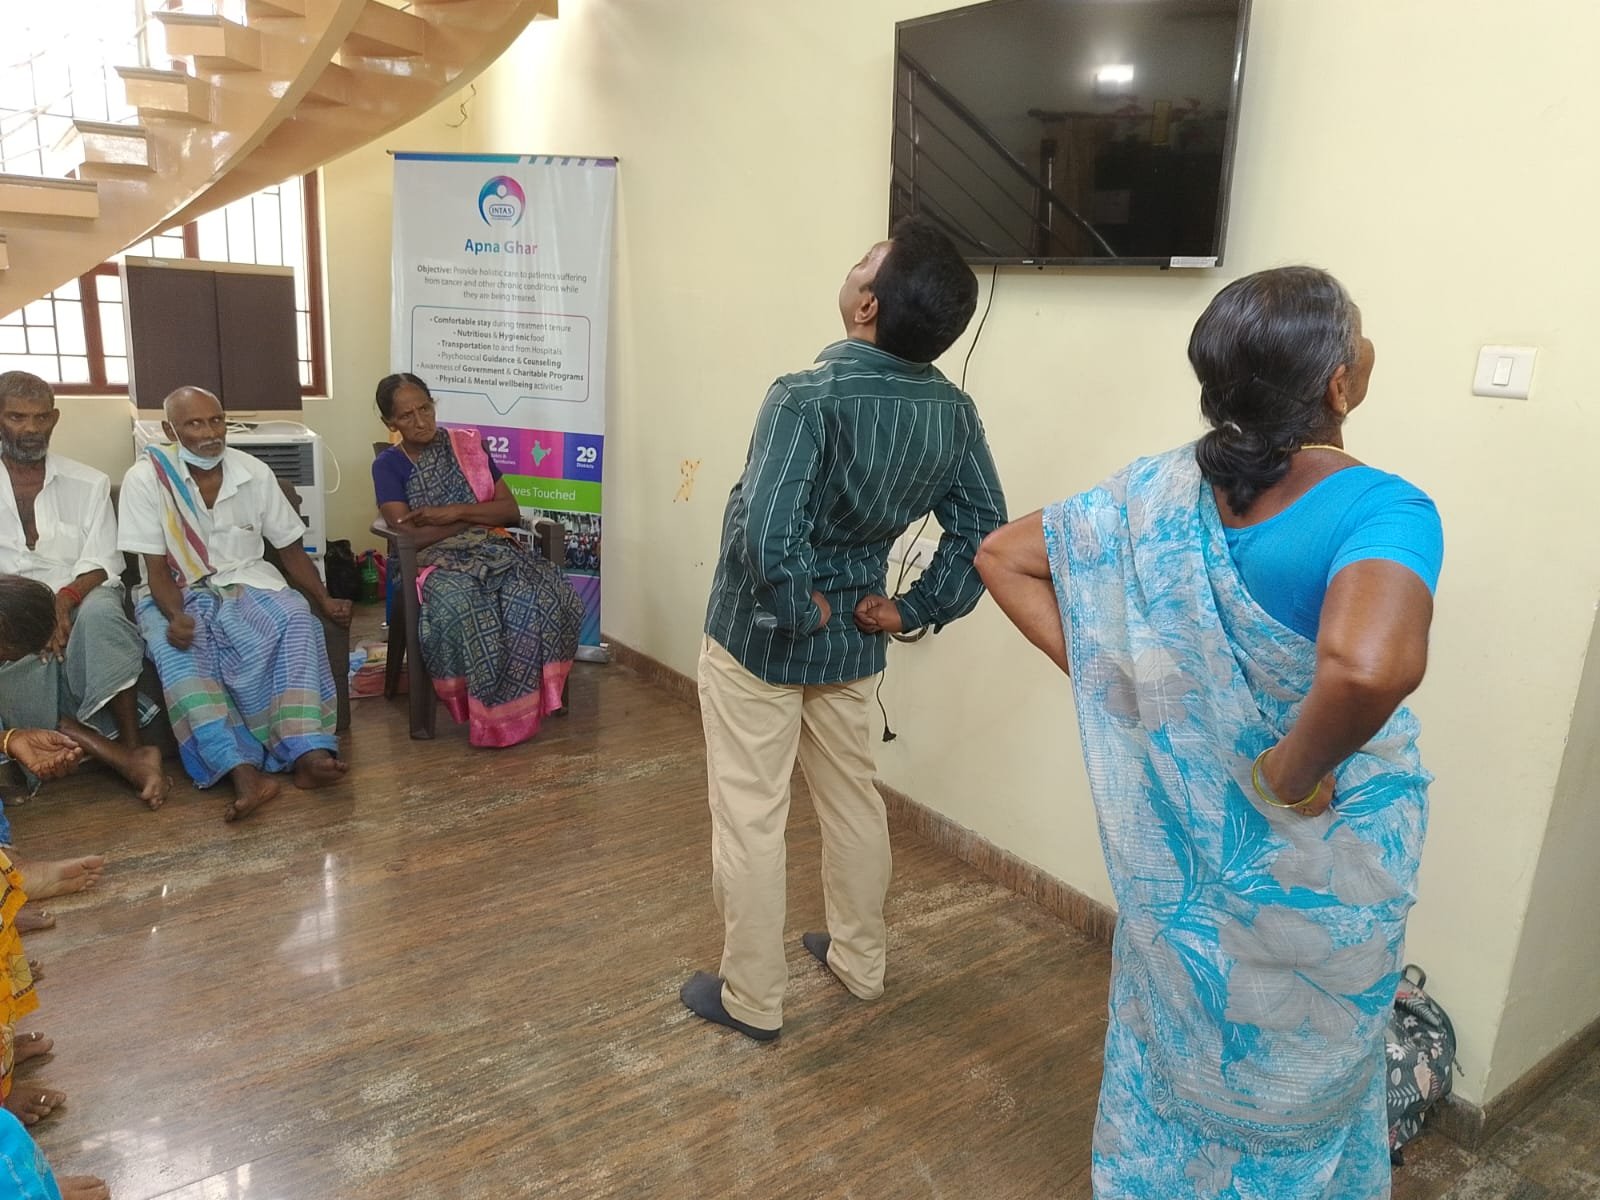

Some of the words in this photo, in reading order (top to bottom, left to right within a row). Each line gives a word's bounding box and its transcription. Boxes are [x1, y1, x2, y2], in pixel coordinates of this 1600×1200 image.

[492, 207, 512, 215] INTAS
[464, 238, 500, 255] Apna
[503, 240, 538, 255] Ghar
[417, 265, 452, 274] Objective:
[453, 266, 478, 275] Provide
[520, 271, 527, 279] to
[528, 271, 556, 280] patients
[557, 272, 587, 284] suffering
[424, 276, 440, 285] from
[441, 279, 462, 287] cancer
[463, 279, 477, 287] and
[478, 280, 496, 288] other
[497, 280, 522, 290] chronic
[523, 283, 559, 292] conditions
[560, 284, 579, 294] while
[463, 291, 478, 300] they
[490, 292, 511, 303] being
[433, 315, 476, 326] Comfortable
[477, 319, 491, 328] stay
[492, 320, 515, 330] during
[516, 322, 548, 331] treatment
[457, 329, 492, 339] Nutritious
[499, 331, 530, 343] Hygienic
[530, 334, 545, 343] food
[441, 340, 492, 350] Transportation
[501, 344, 514, 352] and
[515, 345, 531, 353] from
[532, 346, 563, 356] Hospitals
[441, 351, 482, 361] Psychosocial
[482, 354, 515, 364] Guidance
[523, 357, 562, 369] Counseling
[420, 362, 453, 370] Awareness
[454, 363, 462, 371] of
[462, 364, 505, 375] Government
[513, 368, 548, 378] Charitable
[549, 371, 584, 382] Programs
[439, 374, 467, 384] Physical
[474, 377, 498, 386] Mental
[498, 379, 533, 391] wellbeing
[533, 382, 563, 391] activities
[487, 436, 509, 453] 22
[576, 446, 597, 463] 29
[511, 485, 531, 497] ives
[532, 487, 576, 501] Touched
